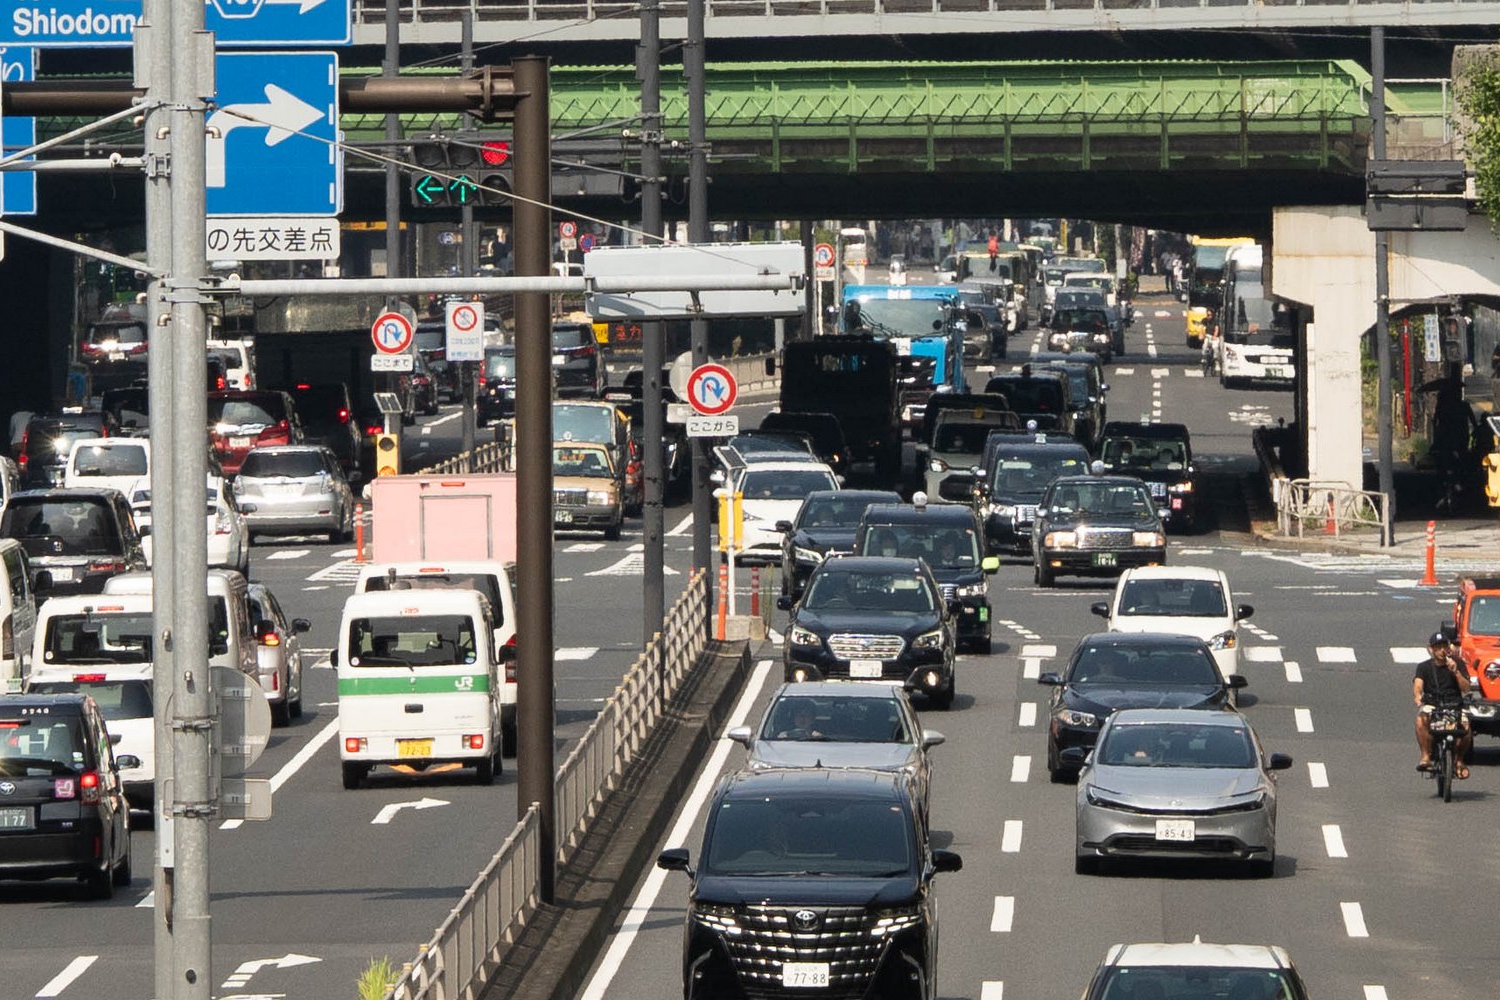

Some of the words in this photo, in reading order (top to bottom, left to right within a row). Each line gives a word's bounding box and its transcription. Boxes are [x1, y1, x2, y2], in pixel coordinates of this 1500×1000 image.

[690, 420, 736, 432] ここから
[454, 676, 474, 687] JR
[1164, 828, 1192, 839] 85-43
[792, 973, 827, 985] 77-88
